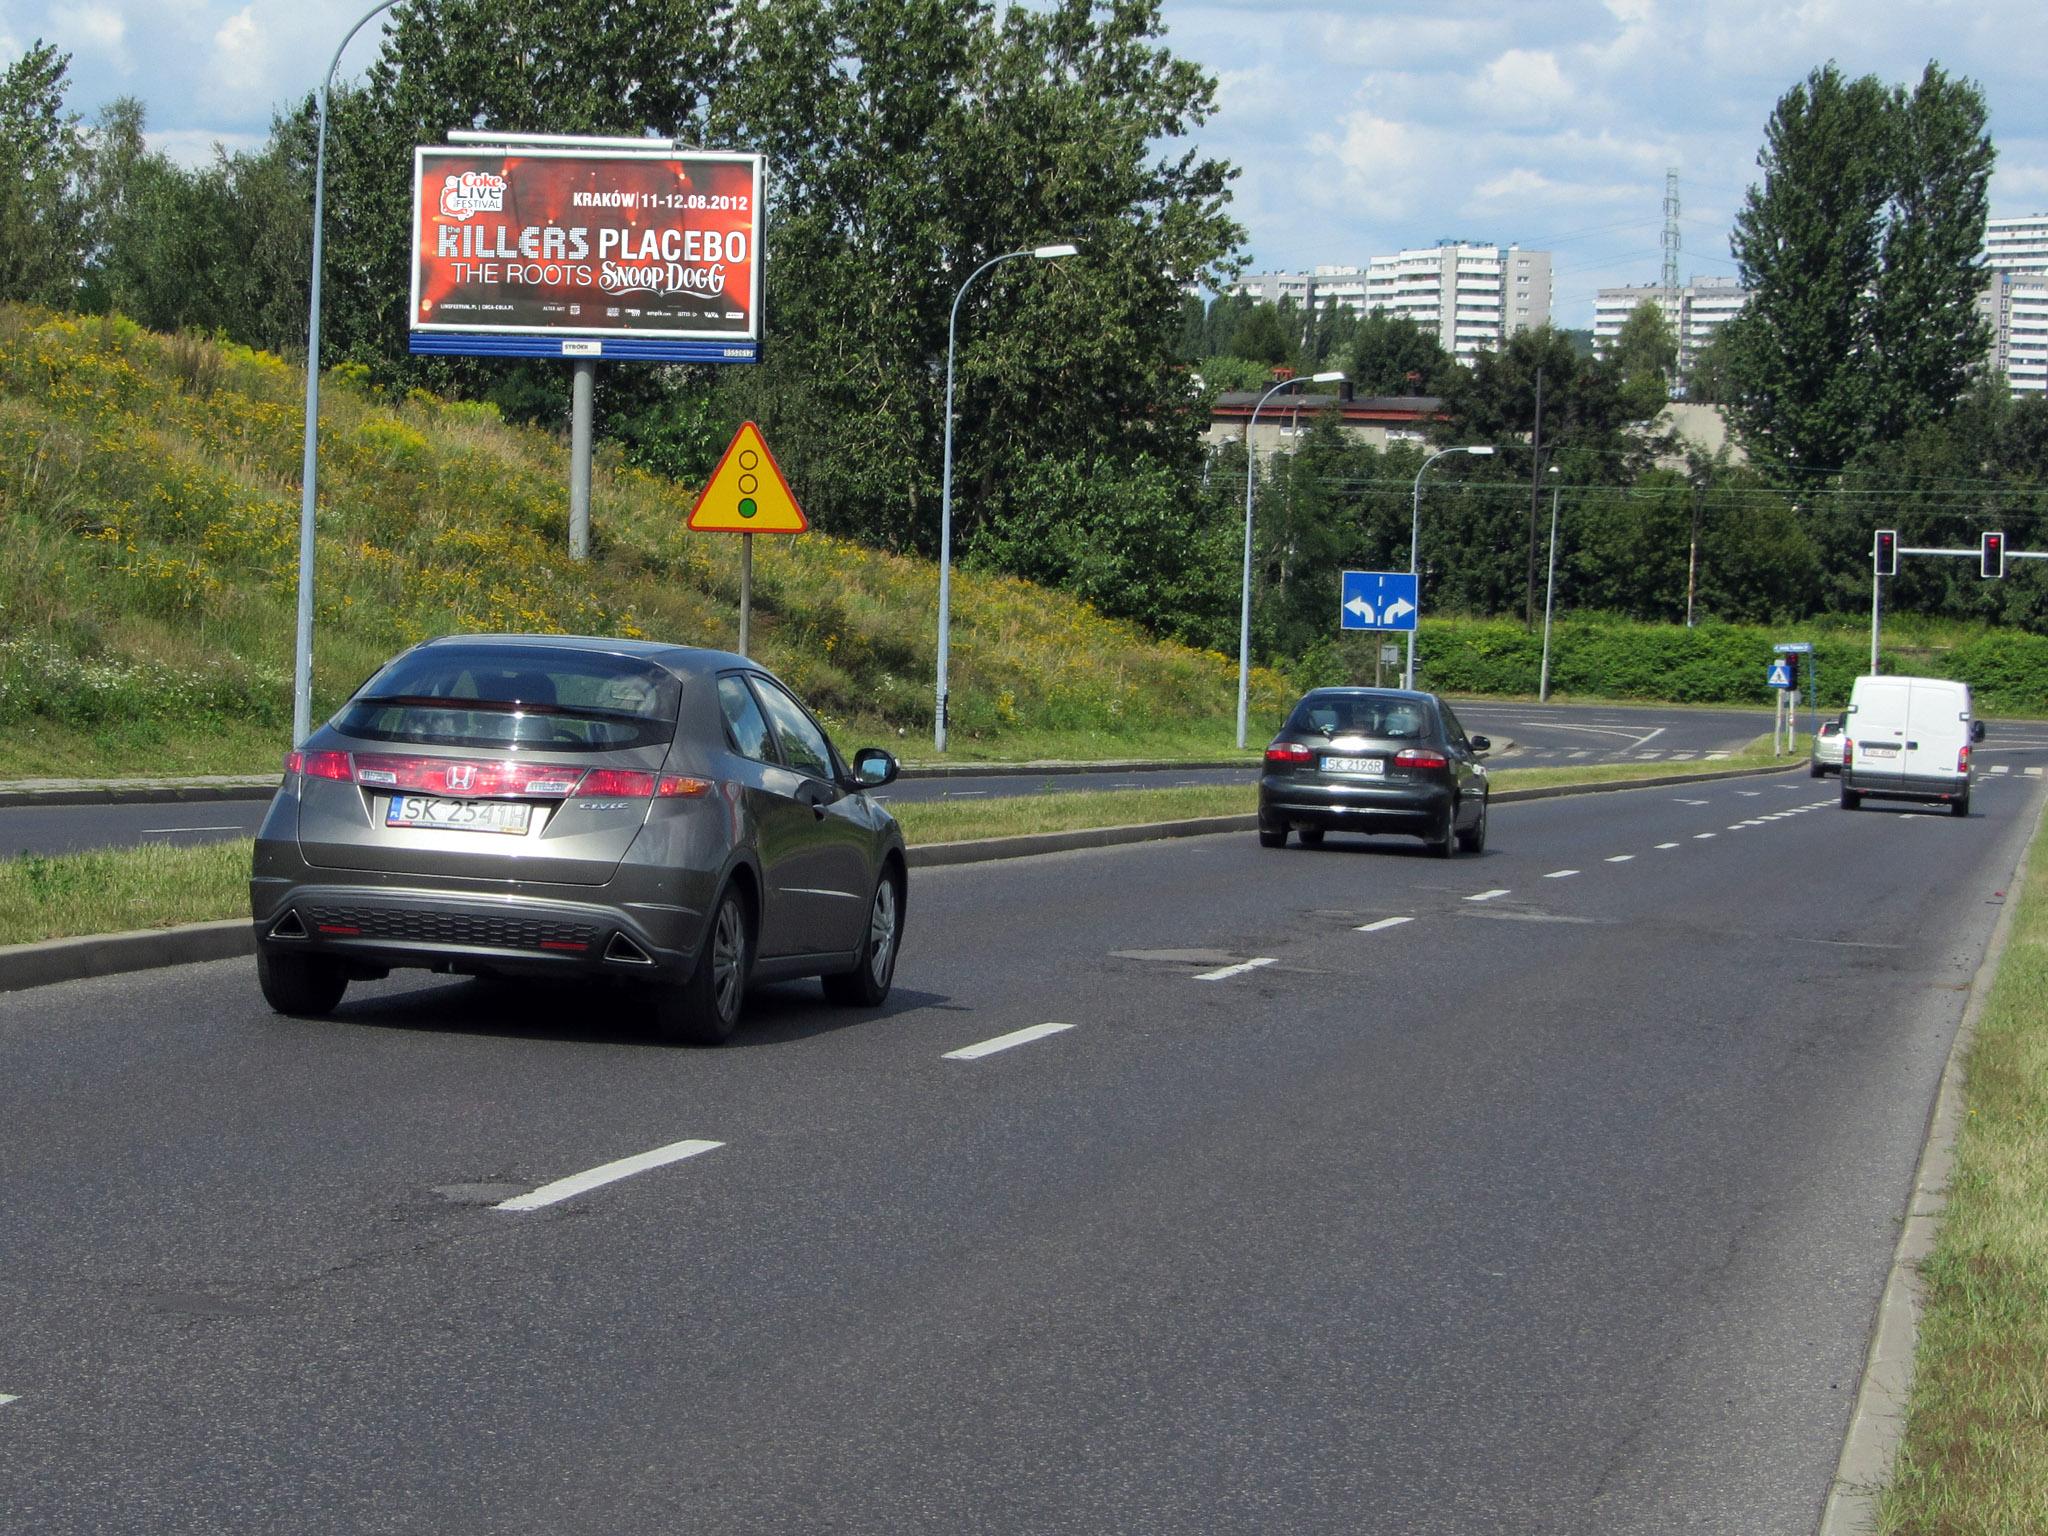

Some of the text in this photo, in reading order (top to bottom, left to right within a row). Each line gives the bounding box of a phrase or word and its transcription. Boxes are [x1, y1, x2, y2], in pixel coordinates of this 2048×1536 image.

[457, 180, 501, 199] Live
[462, 173, 501, 187] Coke
[456, 199, 500, 209] FESTIVAL
[573, 190, 748, 210] KRAKÓW 11-12.08.2012
[438, 224, 589, 260] KILLERS
[599, 228, 746, 263] PLACEBO
[451, 263, 592, 286] THE ROOTS
[1328, 759, 1382, 772] SK 2196R
[405, 799, 439, 821] SK
